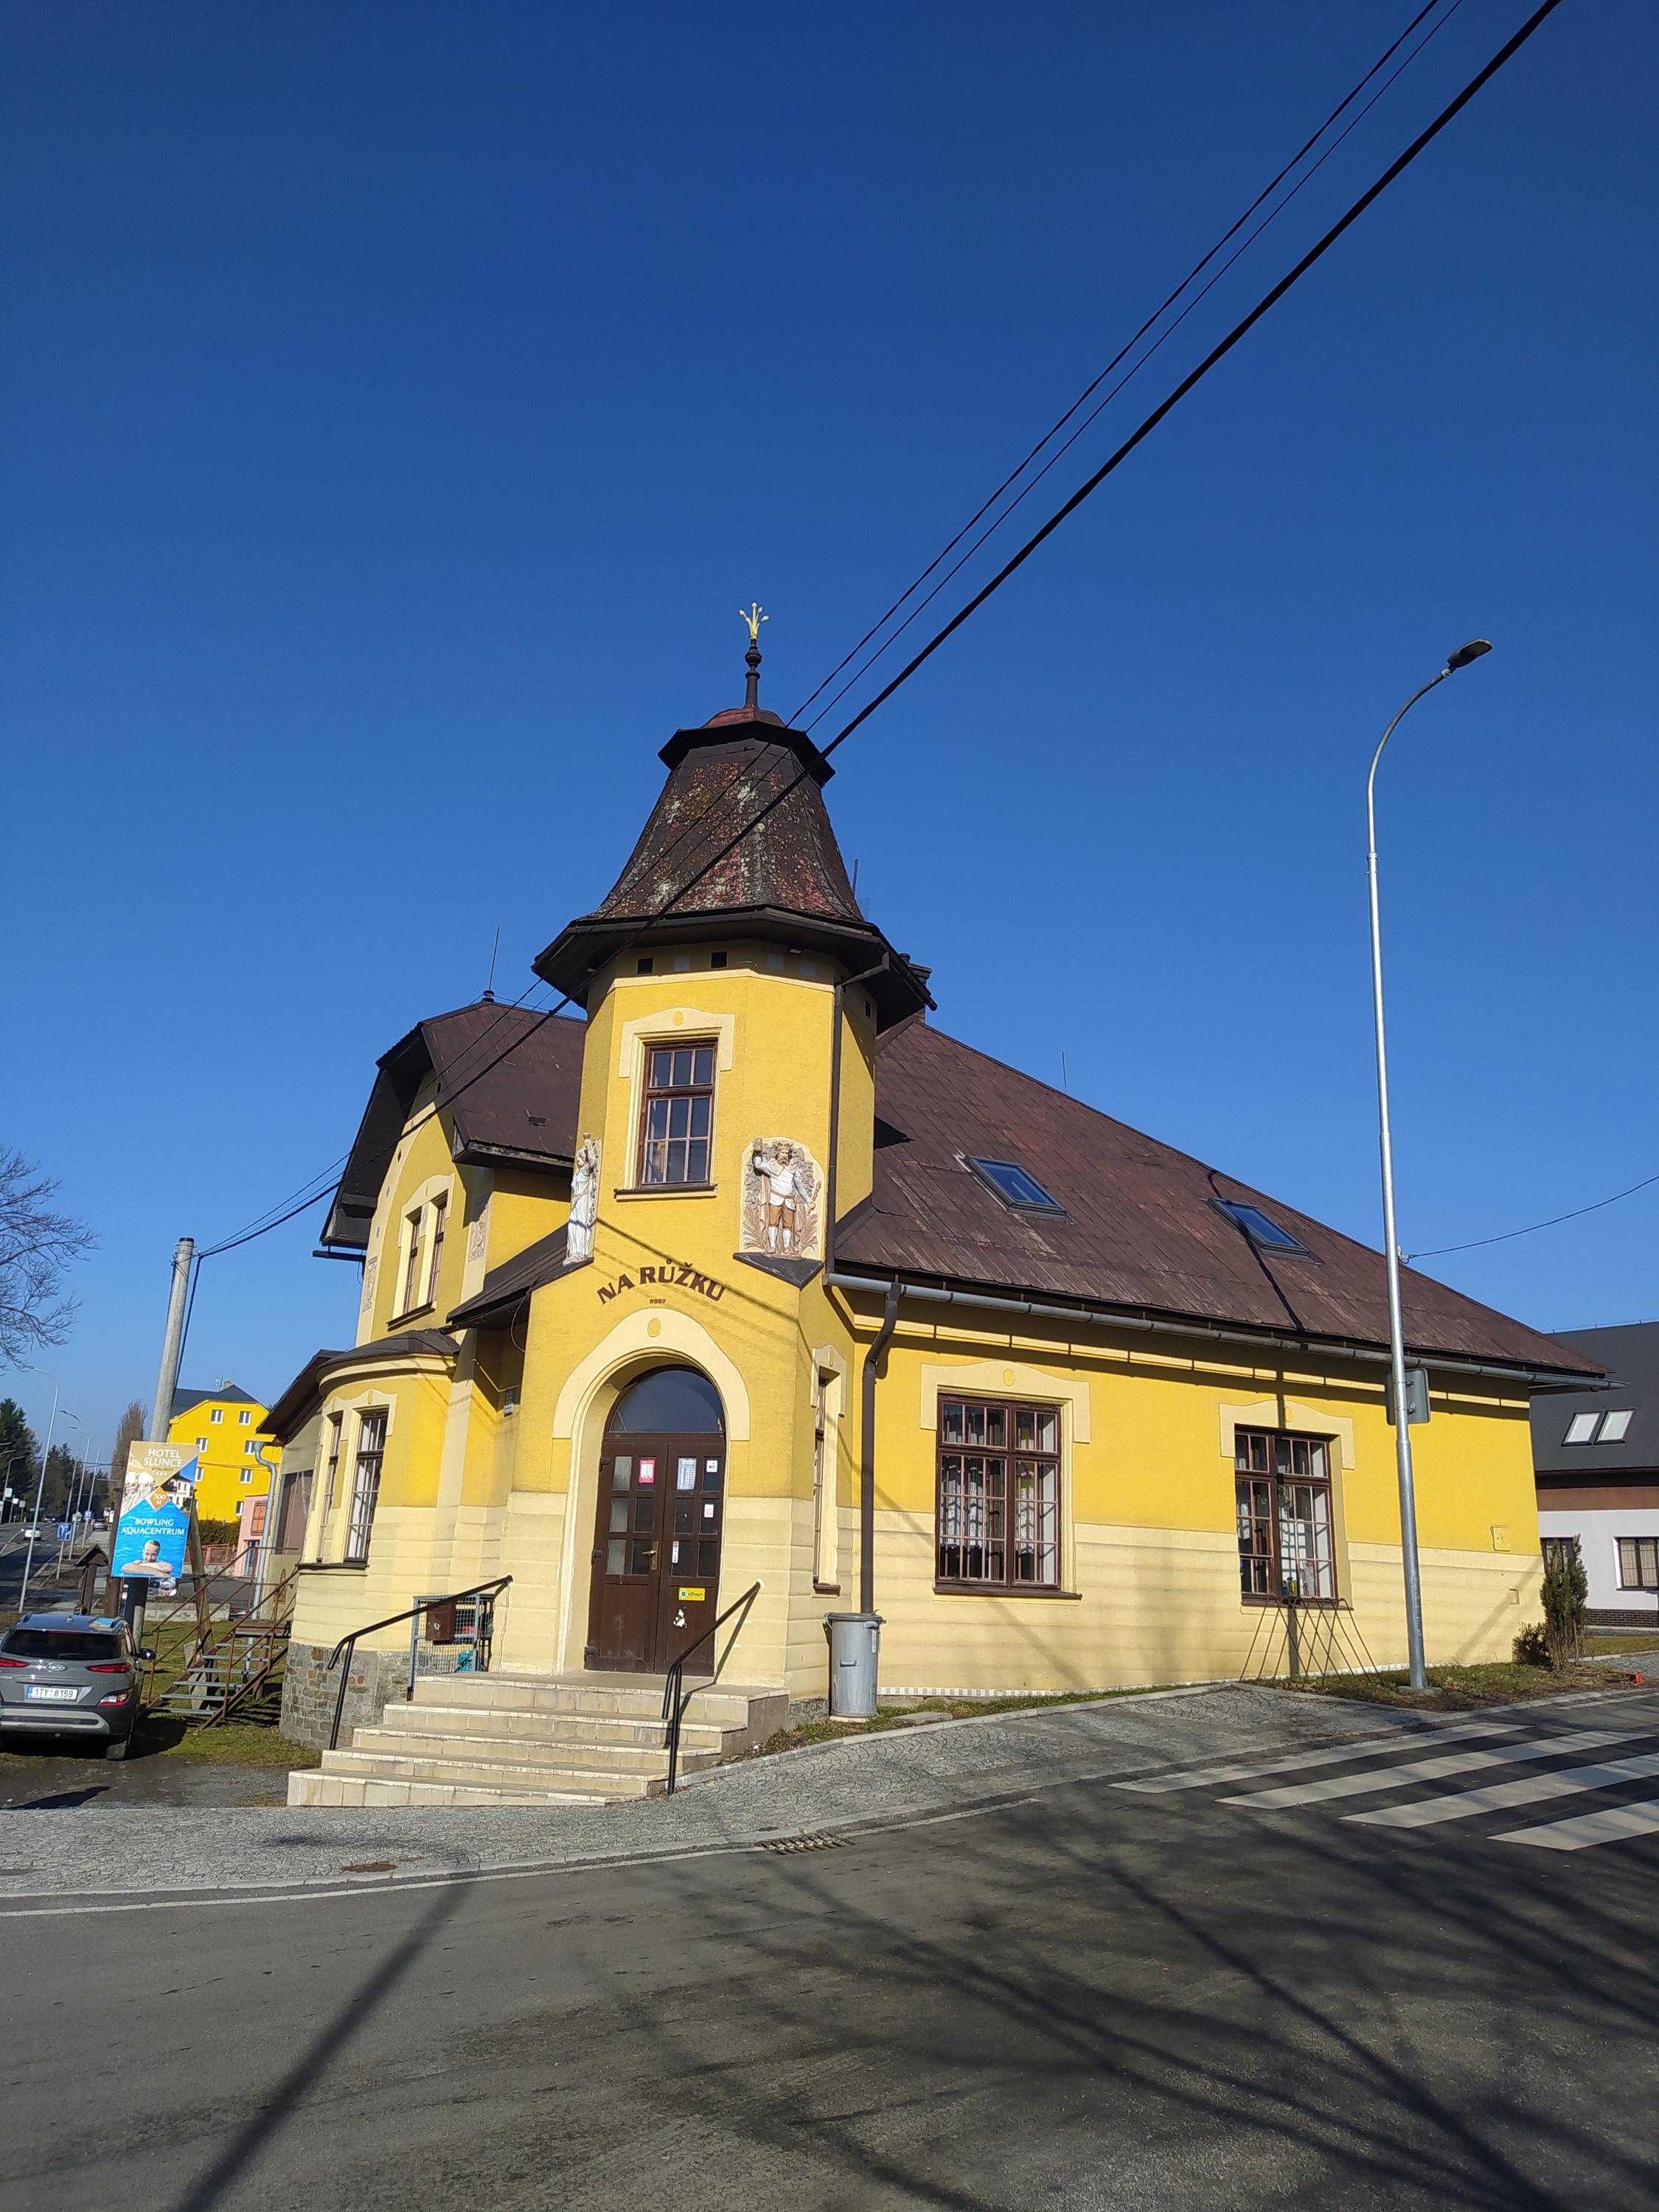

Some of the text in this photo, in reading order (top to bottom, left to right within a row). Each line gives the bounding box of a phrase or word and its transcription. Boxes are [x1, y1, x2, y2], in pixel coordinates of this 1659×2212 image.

[597, 1259, 726, 1305] NA RŮŽKU
[147, 1448, 181, 1458] HOTEL
[143, 1457, 183, 1467] SLUNCE
[135, 1518, 174, 1526] BOWLING
[121, 1526, 184, 1535] AQUACENTRUM
[35, 1688, 74, 1698] 1TY 8159
